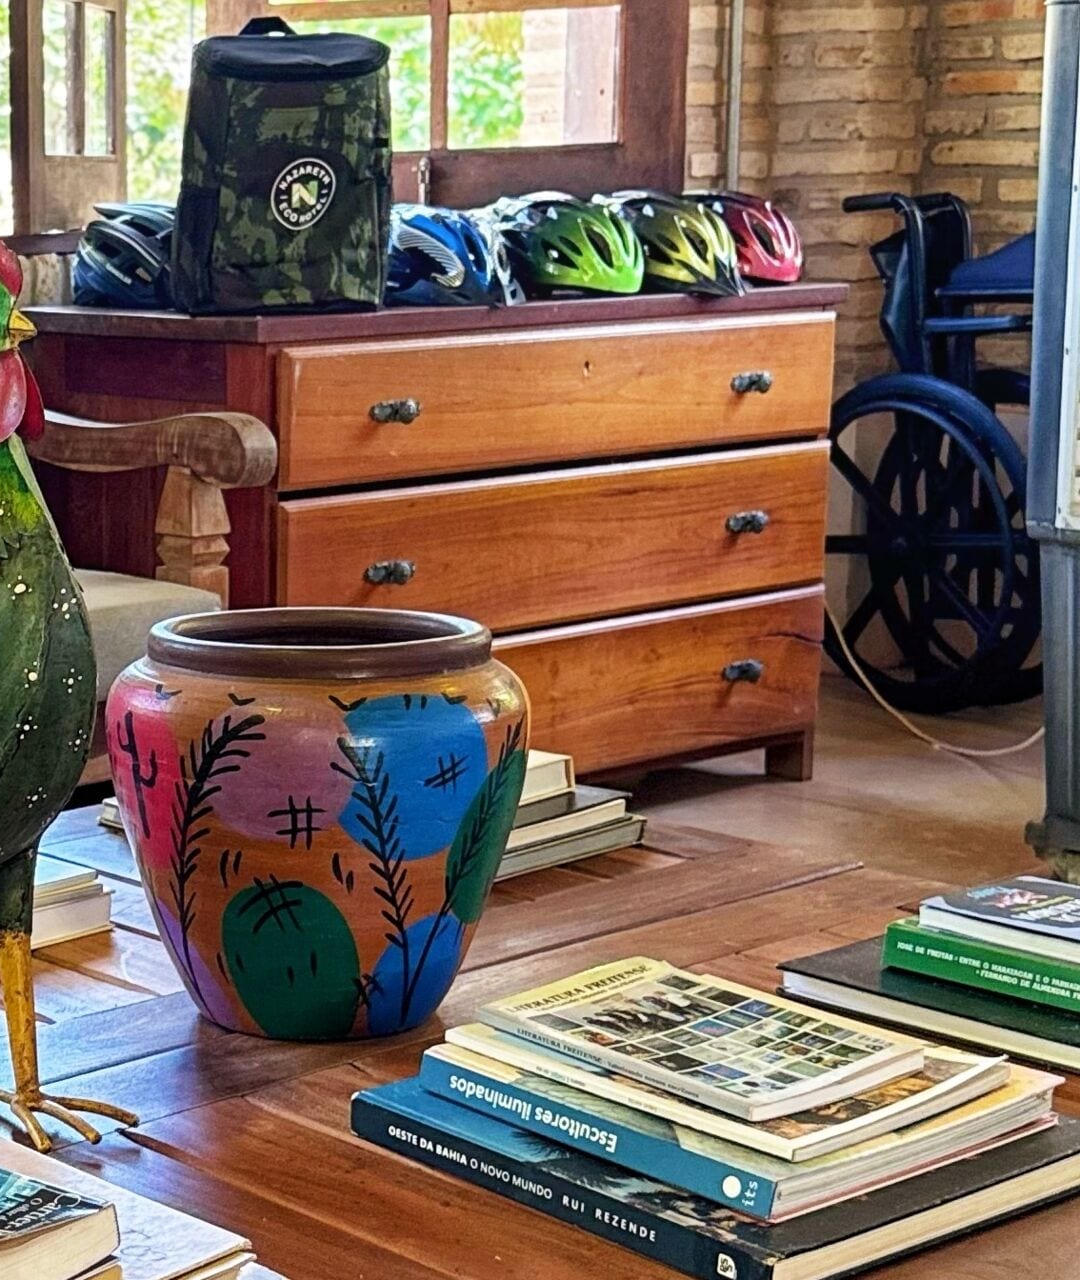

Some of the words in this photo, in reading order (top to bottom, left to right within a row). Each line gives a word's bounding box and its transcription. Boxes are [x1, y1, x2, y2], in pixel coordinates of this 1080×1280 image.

[279, 165, 331, 190] NAZARETH
[279, 202, 298, 223] ECO
[506, 986, 584, 1013] LITERATURA
[584, 965, 652, 992] FREITENSE
[449, 1074, 532, 1121] iluminados
[534, 1106, 618, 1154] Escultores
[388, 1125, 418, 1146] OESTE
[419, 1137, 434, 1152] DA
[435, 1144, 468, 1166] BAHIA
[469, 1158, 479, 1169] O
[480, 1162, 510, 1182] NOVO
[511, 1174, 553, 1199] MUNDO
[562, 1195, 585, 1213] RUI
[595, 1207, 657, 1242] REZENDE
[742, 1180, 759, 1208] its
